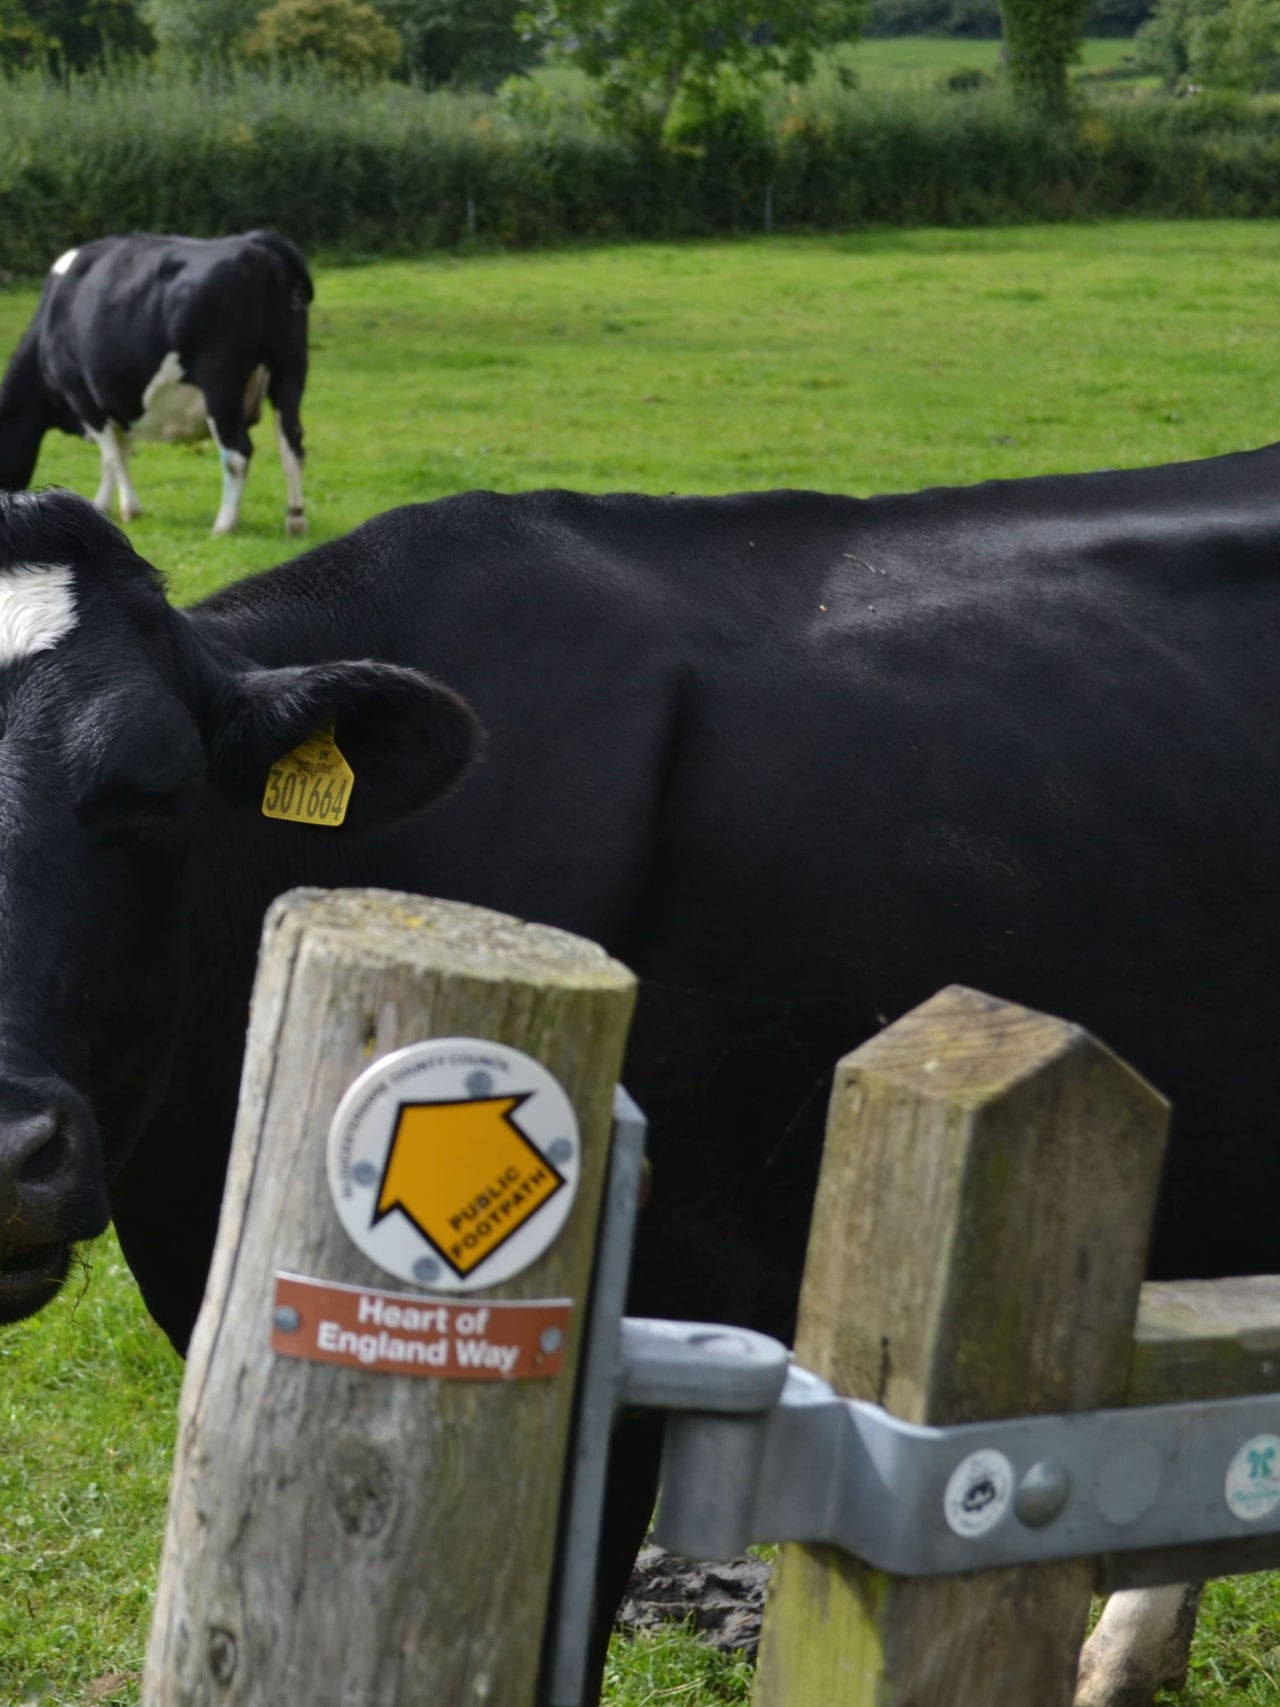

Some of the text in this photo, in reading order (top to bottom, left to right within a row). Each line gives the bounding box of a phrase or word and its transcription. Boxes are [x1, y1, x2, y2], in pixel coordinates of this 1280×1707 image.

[266, 769, 348, 821] 301664
[449, 1165, 519, 1232] PUBLIC
[451, 1169, 546, 1259] FOOTPATH
[357, 1295, 490, 1335] Heart of
[317, 1321, 519, 1373] England Way
